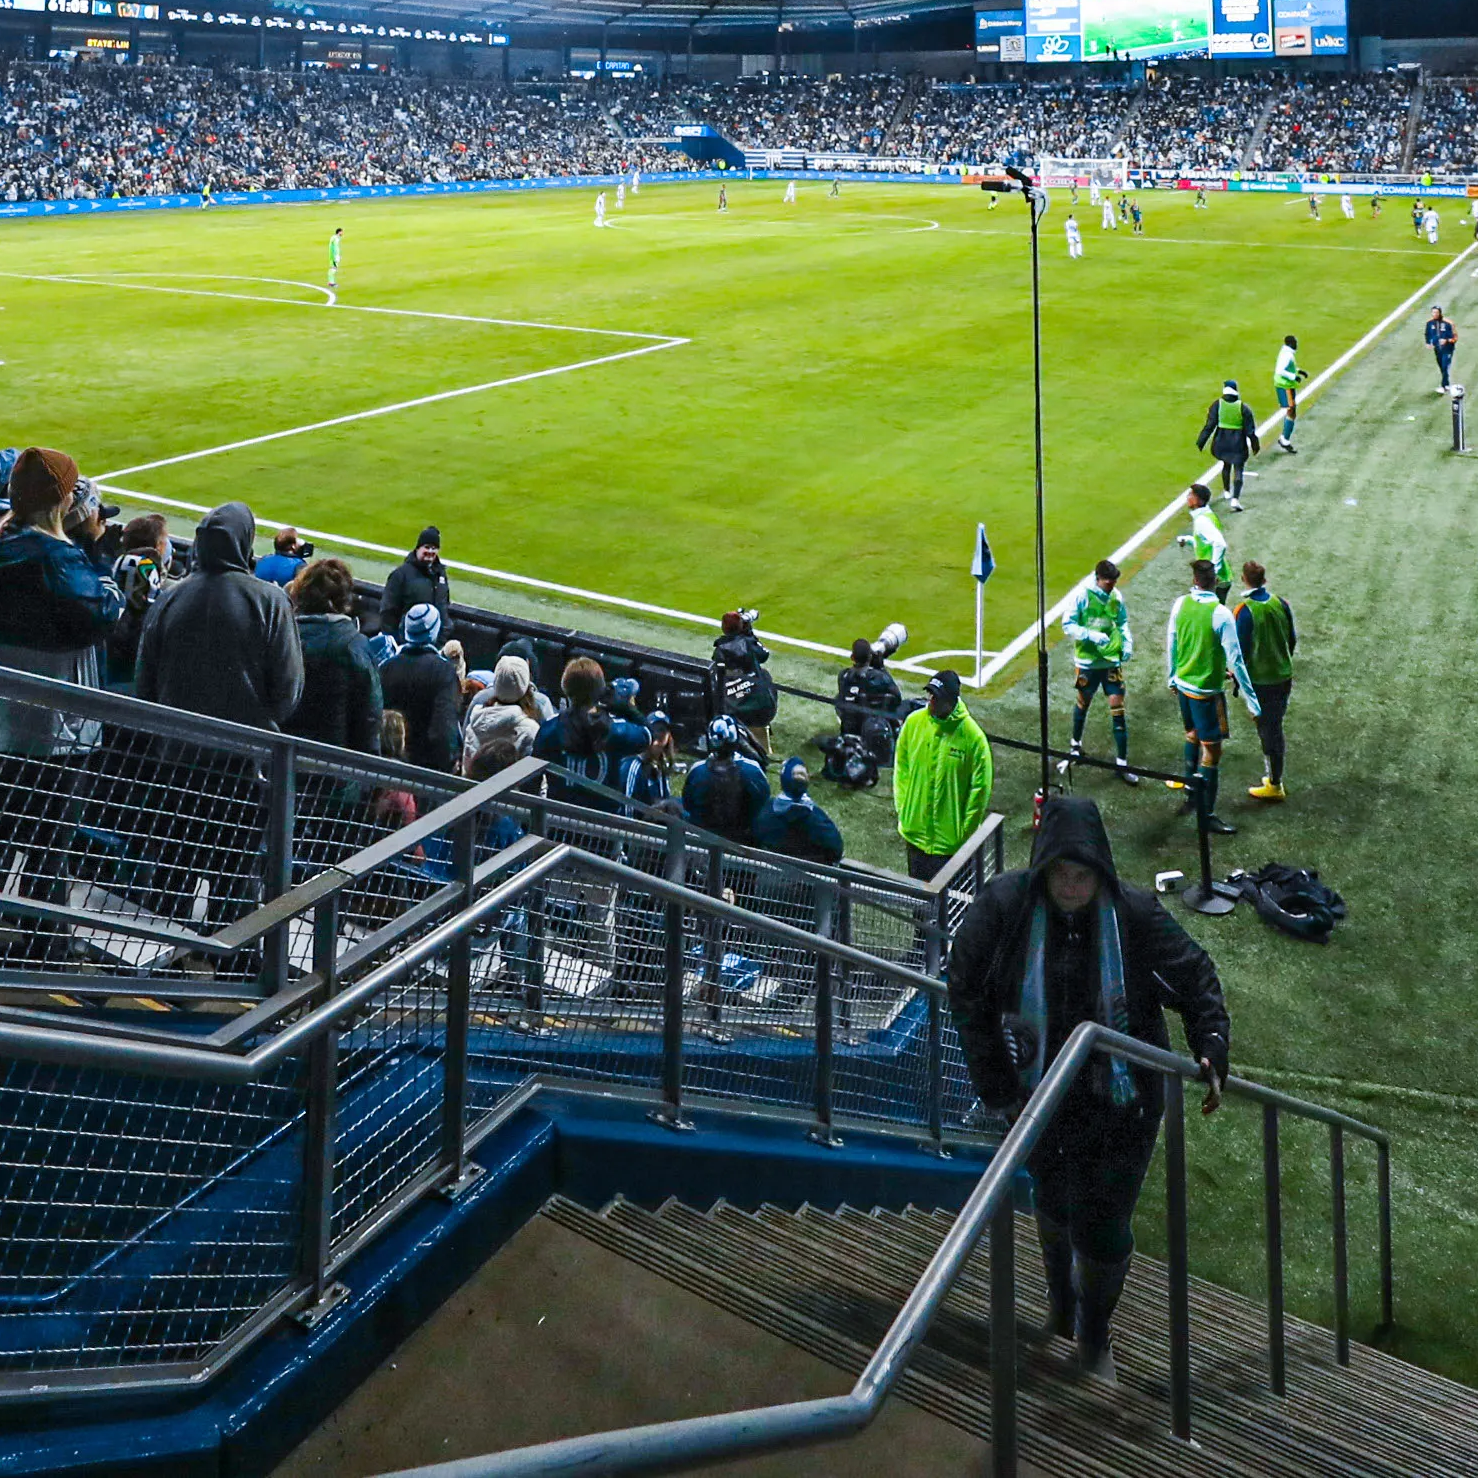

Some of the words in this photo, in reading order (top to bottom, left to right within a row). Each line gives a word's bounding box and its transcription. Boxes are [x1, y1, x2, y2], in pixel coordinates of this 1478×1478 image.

[98, 3, 112, 13] LA
[1314, 34, 1344, 48] UMKC
[605, 61, 630, 70] CAPITAN
[1382, 185, 1421, 195] COMPASS
[1426, 186, 1466, 196] MINERALS
